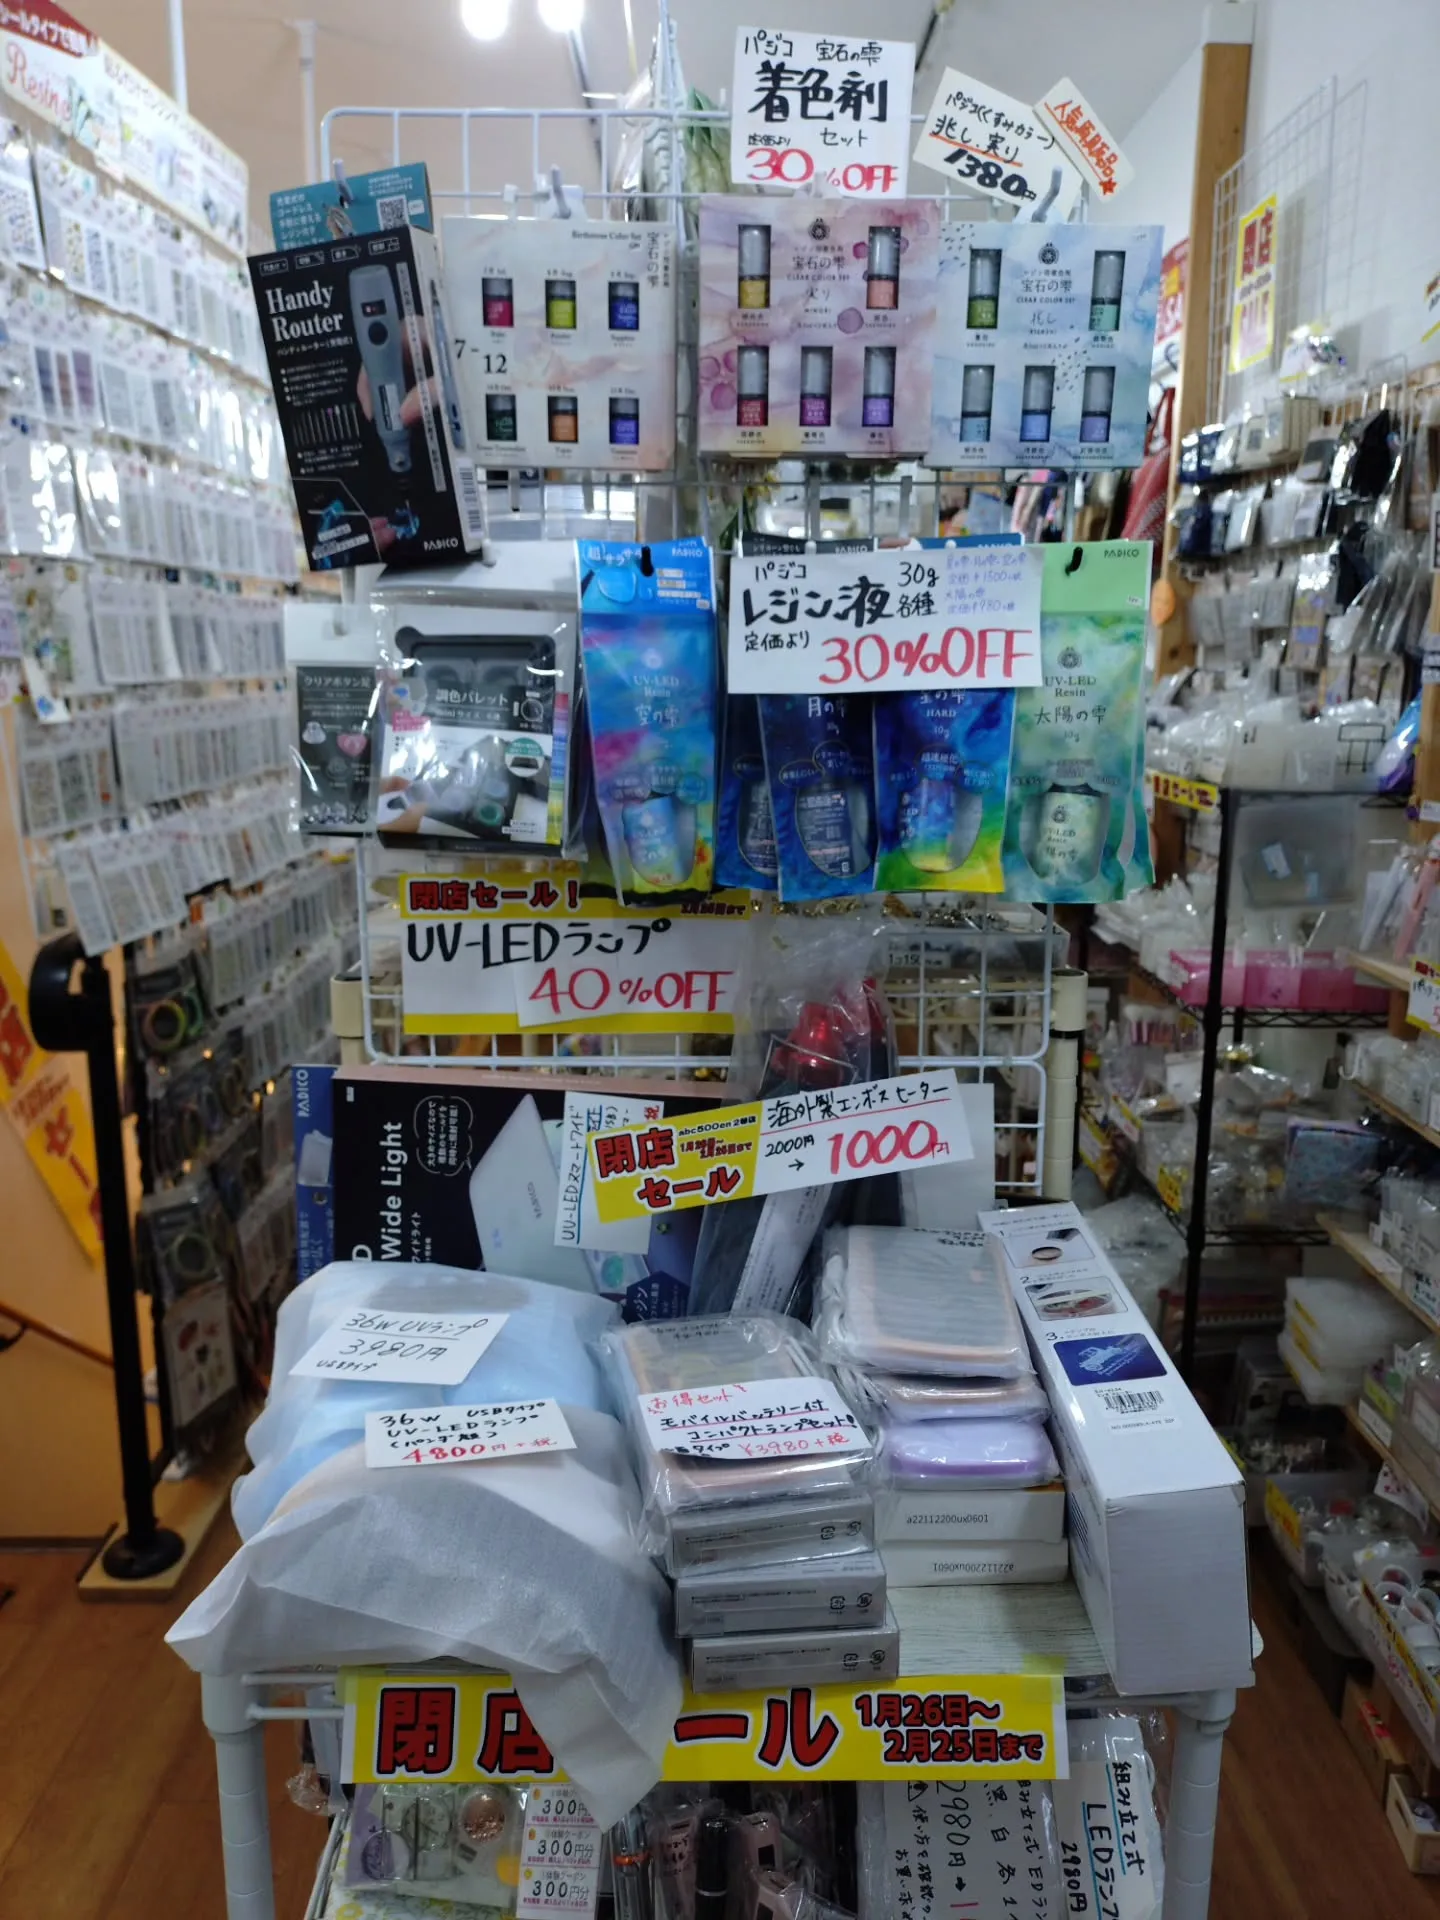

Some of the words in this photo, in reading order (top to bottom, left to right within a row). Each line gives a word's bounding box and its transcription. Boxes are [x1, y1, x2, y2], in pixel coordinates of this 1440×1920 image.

[744, 30, 794, 58] パジコ
[815, 41, 883, 66] 宝石の雫
[748, 60, 889, 122] 着色剤
[820, 127, 868, 146] セット
[265, 280, 334, 316] Handy
[1021, 279, 1073, 294] 宝石の雫
[271, 311, 344, 343] Router
[423, 537, 459, 552] PADICO
[1103, 547, 1140, 558] PADICO
[754, 561, 807, 583] パジコ
[899, 561, 941, 588] 30g
[742, 575, 895, 628] レジン液
[899, 592, 938, 618] 各種
[744, 630, 811, 653] 定価より
[819, 626, 1034, 685] 30%OFF
[1045, 675, 1097, 687] UV-LED
[1055, 687, 1086, 698] Resin
[436, 688, 509, 706] 調色パレット
[926, 709, 957, 717] HARD
[1034, 705, 1107, 725] 太陽の雫
[407, 917, 673, 969] UV-LEDランプ
[528, 967, 735, 1016] 40%OFF
[296, 1069, 309, 1118] PADICO
[426, 1101, 437, 1168] 大きめサイズなので
[765, 1133, 816, 1159] 2000円
[827, 1119, 950, 1175] 1000円
[380, 1121, 408, 1187] Light
[595, 1128, 677, 1181] 閉店
[636, 1166, 742, 1210] セール
[380, 1195, 402, 1260] Wide
[338, 1338, 449, 1362] 3980円
[387, 1413, 539, 1438] UV-LEDランプ
[660, 1398, 824, 1428] モバイルバッテリー付
[906, 1512, 990, 1525] a22112200ux0601
[882, 1729, 1045, 1764] 2月25日まで
[1112, 1761, 1145, 1876] 組み立て式
[537, 1839, 595, 1859] 300円分
[532, 1880, 591, 1901] 300円分
[1061, 1841, 1088, 1913] 2980円
